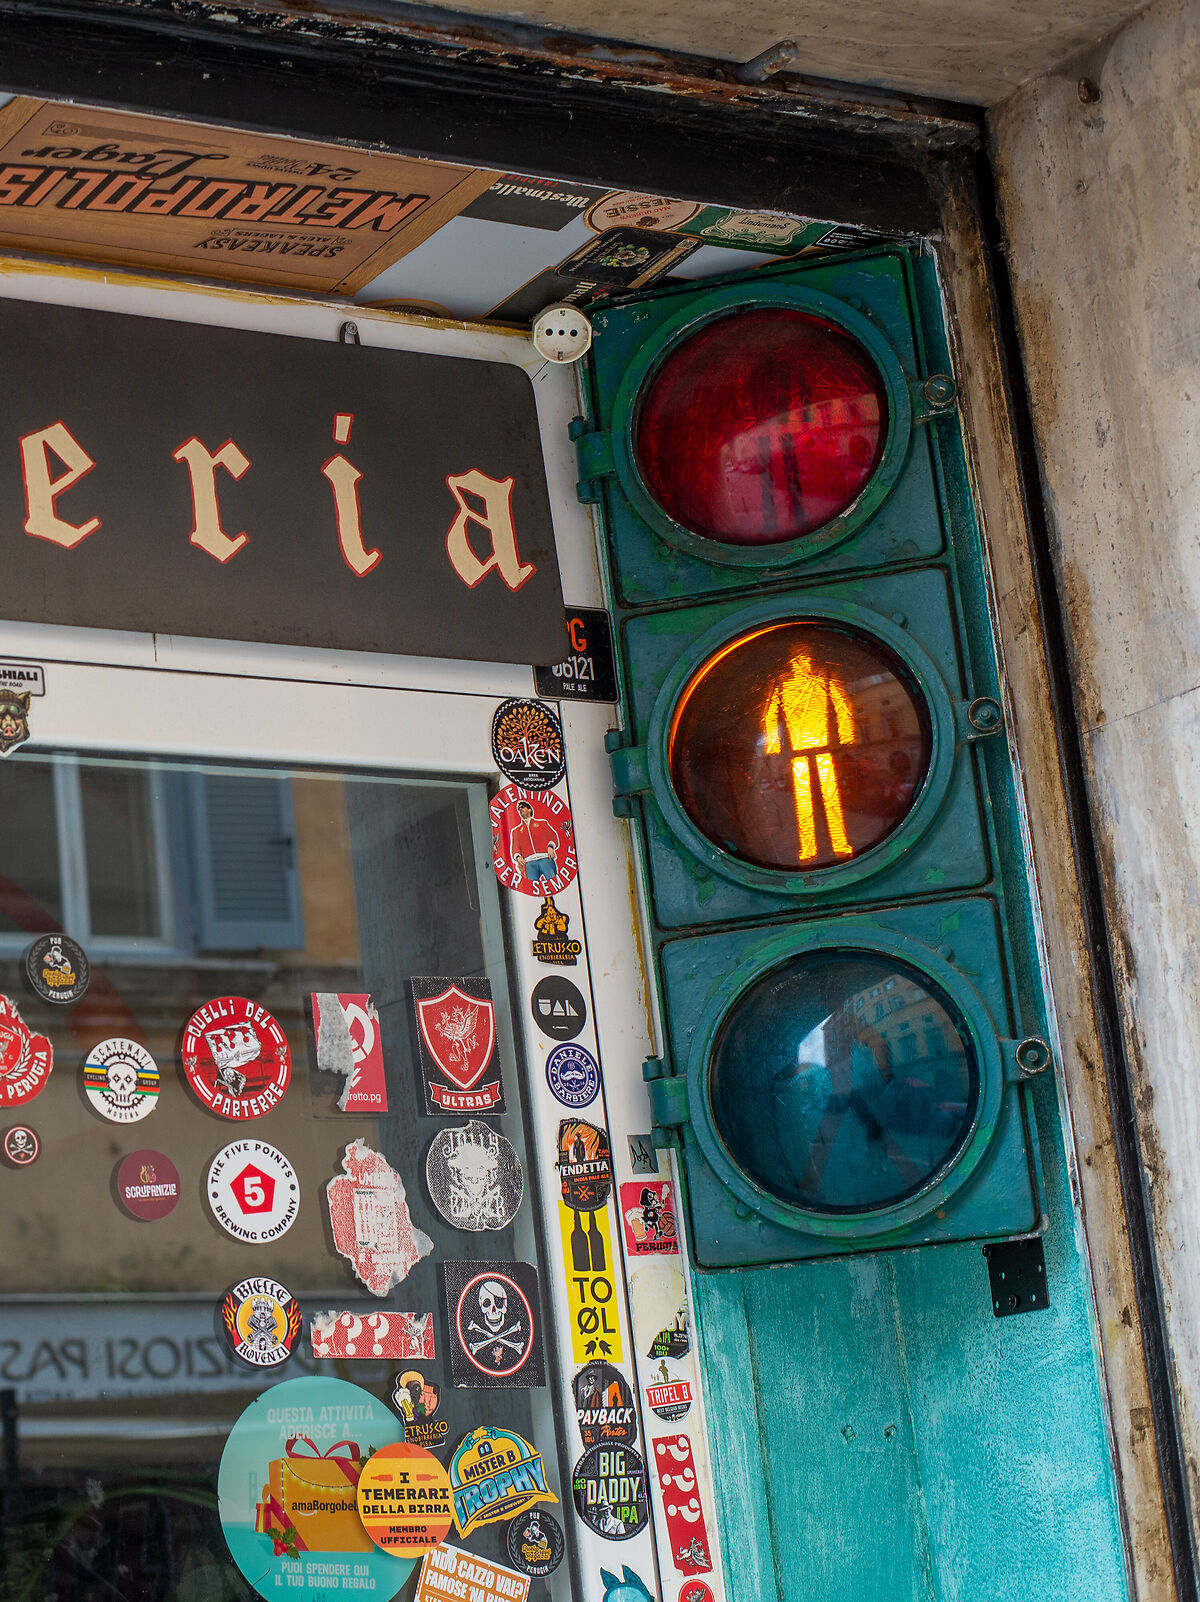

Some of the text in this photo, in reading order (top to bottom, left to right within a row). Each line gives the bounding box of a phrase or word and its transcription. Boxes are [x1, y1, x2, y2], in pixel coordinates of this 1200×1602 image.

[21, 143, 231, 179] Lager
[307, 161, 362, 182] 24
[490, 182, 590, 209] Westmalle
[234, 229, 331, 243] ALES LAGERS
[193, 236, 345, 261] SPEAKEASY
[562, 682, 588, 692] PALE ALE
[500, 737, 561, 770] OAKEN
[490, 786, 564, 828] VALENTINO
[493, 845, 577, 896] PER SEMPRE
[48, 990, 74, 1000] PERUGIA
[245, 1002, 271, 1029] DEL
[92, 1041, 152, 1066] SCATENATI
[551, 1050, 593, 1075] DANIELE
[211, 1082, 285, 1117] PARTERRE
[441, 1093, 492, 1107] ULTRAS
[554, 1079, 595, 1102] BARBIERE
[107, 1108, 139, 1120] MODENA
[210, 1143, 294, 1185] THE FIVE POINTS
[555, 1160, 609, 1177] VENDETTA
[243, 1176, 266, 1207] 5
[215, 1197, 298, 1241] BREWING COMPANY
[635, 1240, 678, 1252] PERUGIA
[236, 1279, 289, 1304] BIELLE
[572, 1276, 613, 1304] TO
[577, 1306, 616, 1336] ØL
[238, 1343, 289, 1366] ROVENTI
[648, 1384, 689, 1405] TRIPEL B
[267, 1402, 374, 1423] QUESTA ATTIVITÀ
[577, 1407, 634, 1426] PAYBACK
[464, 1450, 516, 1481] MISTER B
[599, 1451, 626, 1478] BIG
[399, 1471, 411, 1484] I
[361, 1487, 450, 1501] TEMERARI
[455, 1458, 550, 1527] TROPHY
[586, 1477, 641, 1505] DADDY
[363, 1502, 451, 1515] DELLA BIRRA
[529, 1512, 541, 1520] PUB
[616, 1505, 639, 1524] IPA
[380, 1535, 438, 1546] UFFICIALE
[388, 1525, 428, 1534] MEMBRO
[281, 1562, 369, 1577] PUOI SPENDERE QUI
[457, 1559, 524, 1599] CAZZO VAI?
[526, 1564, 550, 1575] PERUGIA
[274, 1574, 376, 1591] IL TUO BUONO REGALO
[424, 1569, 469, 1600] FAMOSE
